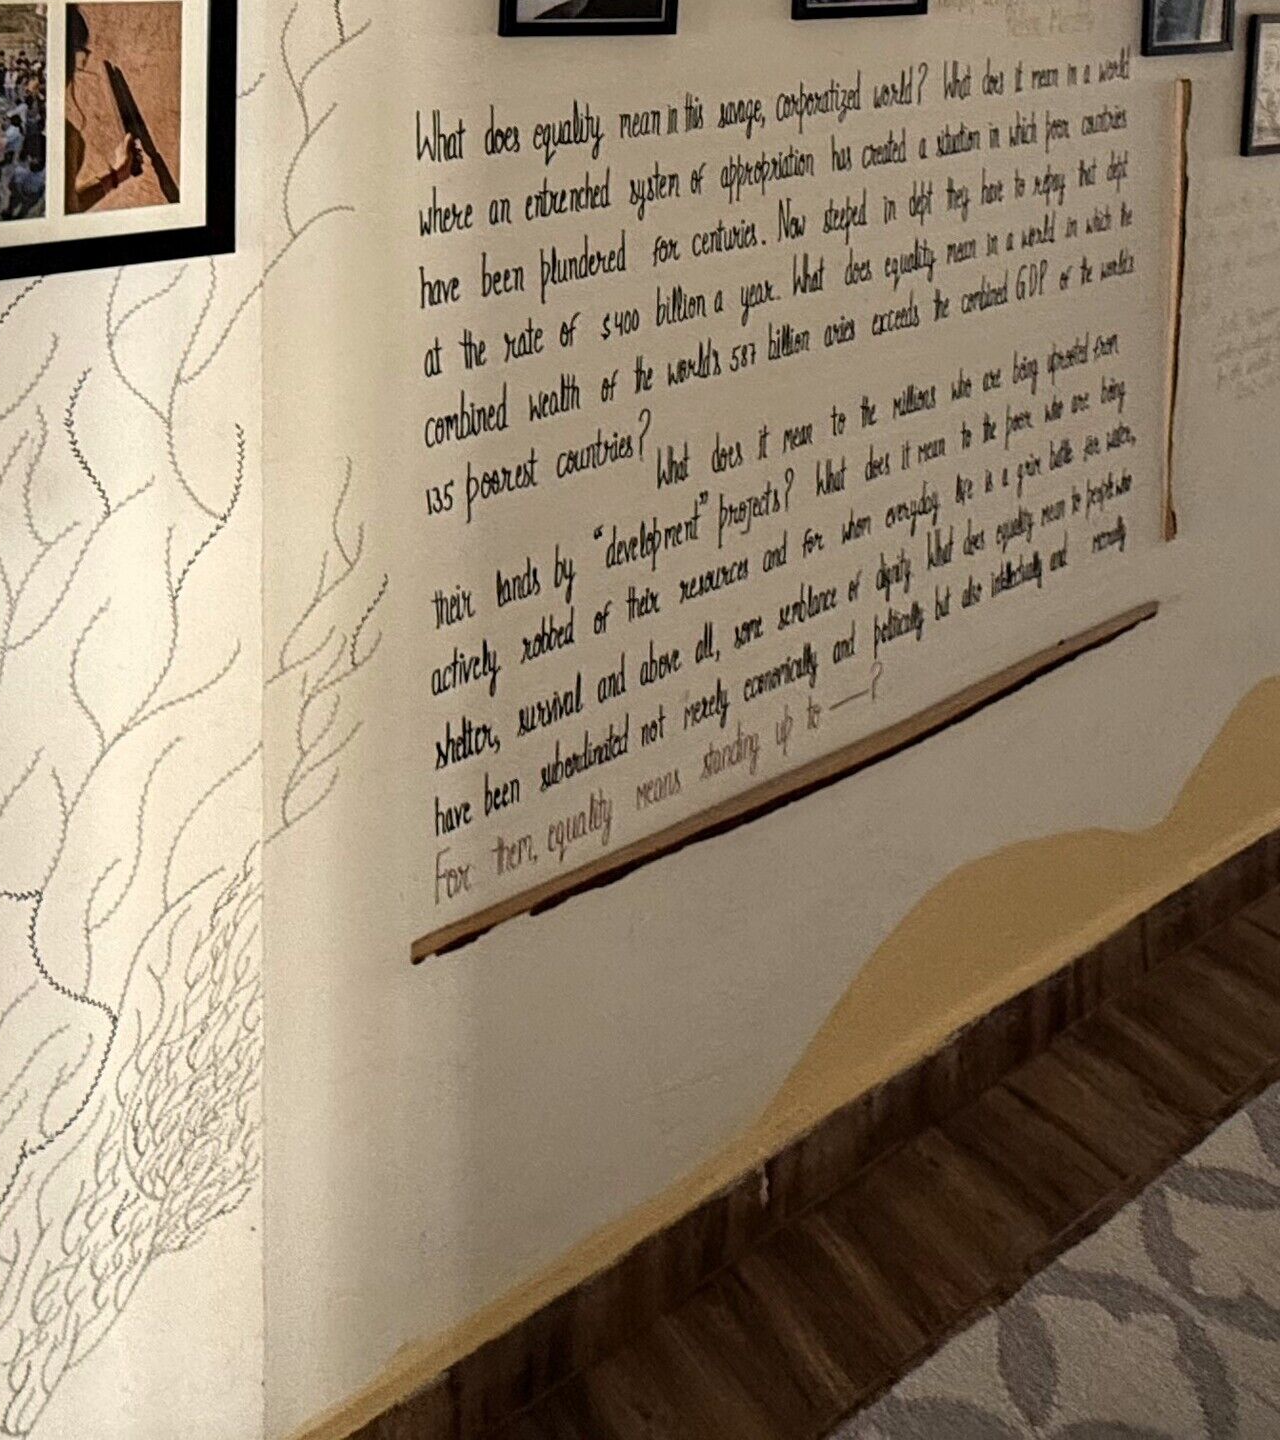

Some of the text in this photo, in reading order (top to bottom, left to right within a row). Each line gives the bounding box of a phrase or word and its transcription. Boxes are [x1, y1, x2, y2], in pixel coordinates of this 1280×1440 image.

[416, 109, 466, 162] What
[484, 104, 520, 156] does
[533, 99, 605, 166] equality
[619, 110, 661, 139] mean
[684, 92, 703, 132] this
[717, 99, 766, 140] savage,
[776, 70, 861, 134] corporatized
[419, 186, 473, 237] where
[489, 198, 512, 226] an
[525, 167, 611, 221] entrenched
[629, 161, 680, 221] system
[690, 162, 706, 194] of
[720, 145, 814, 204] appropriation
[831, 135, 852, 171] has
[419, 266, 460, 309] have
[481, 252, 525, 297] been
[540, 229, 626, 305] plundered
[653, 236, 681, 267] for
[777, 197, 806, 242] Now
[823, 188, 867, 245] steeped
[424, 337, 442, 378] at
[458, 329, 487, 369] the
[504, 317, 544, 363] rate
[559, 312, 581, 347] of
[601, 309, 640, 340] $400
[656, 285, 707, 327] billion
[714, 290, 724, 313] a
[793, 253, 825, 296] What
[424, 382, 509, 448] combined
[529, 373, 580, 422] wealth
[601, 369, 619, 403] of
[634, 355, 653, 394] the
[729, 342, 756, 372] 587
[657, 442, 690, 489] What
[711, 432, 743, 473] does
[757, 425, 770, 460] it
[783, 423, 812, 453] mean
[830, 405, 846, 436] to
[426, 408, 651, 524] 135 poorest countries?
[431, 585, 476, 630] their
[496, 557, 541, 608] lands
[554, 544, 576, 604] by
[718, 467, 794, 549] projects?
[816, 456, 847, 496] What
[431, 639, 501, 697] actively
[520, 606, 575, 664] robbed
[594, 600, 612, 635] of
[625, 586, 660, 622] their
[679, 558, 748, 604] resources
[763, 530, 787, 573] and
[802, 528, 824, 558] for
[517, 672, 584, 737] survival
[597, 652, 626, 704] and
[640, 640, 682, 686] above
[695, 622, 720, 664] all,
[734, 616, 763, 649] some
[777, 583, 837, 631] semblance
[434, 796, 472, 837] have
[484, 772, 520, 817] been
[540, 713, 629, 793] subordinated
[641, 705, 666, 747] not
[684, 678, 730, 730] merely
[743, 643, 818, 702] economically
[833, 620, 855, 664] and
[434, 847, 471, 906] For
[547, 788, 612, 863] equality
[636, 769, 681, 810] means
[700, 721, 760, 780] standing
[776, 705, 793, 756] up
